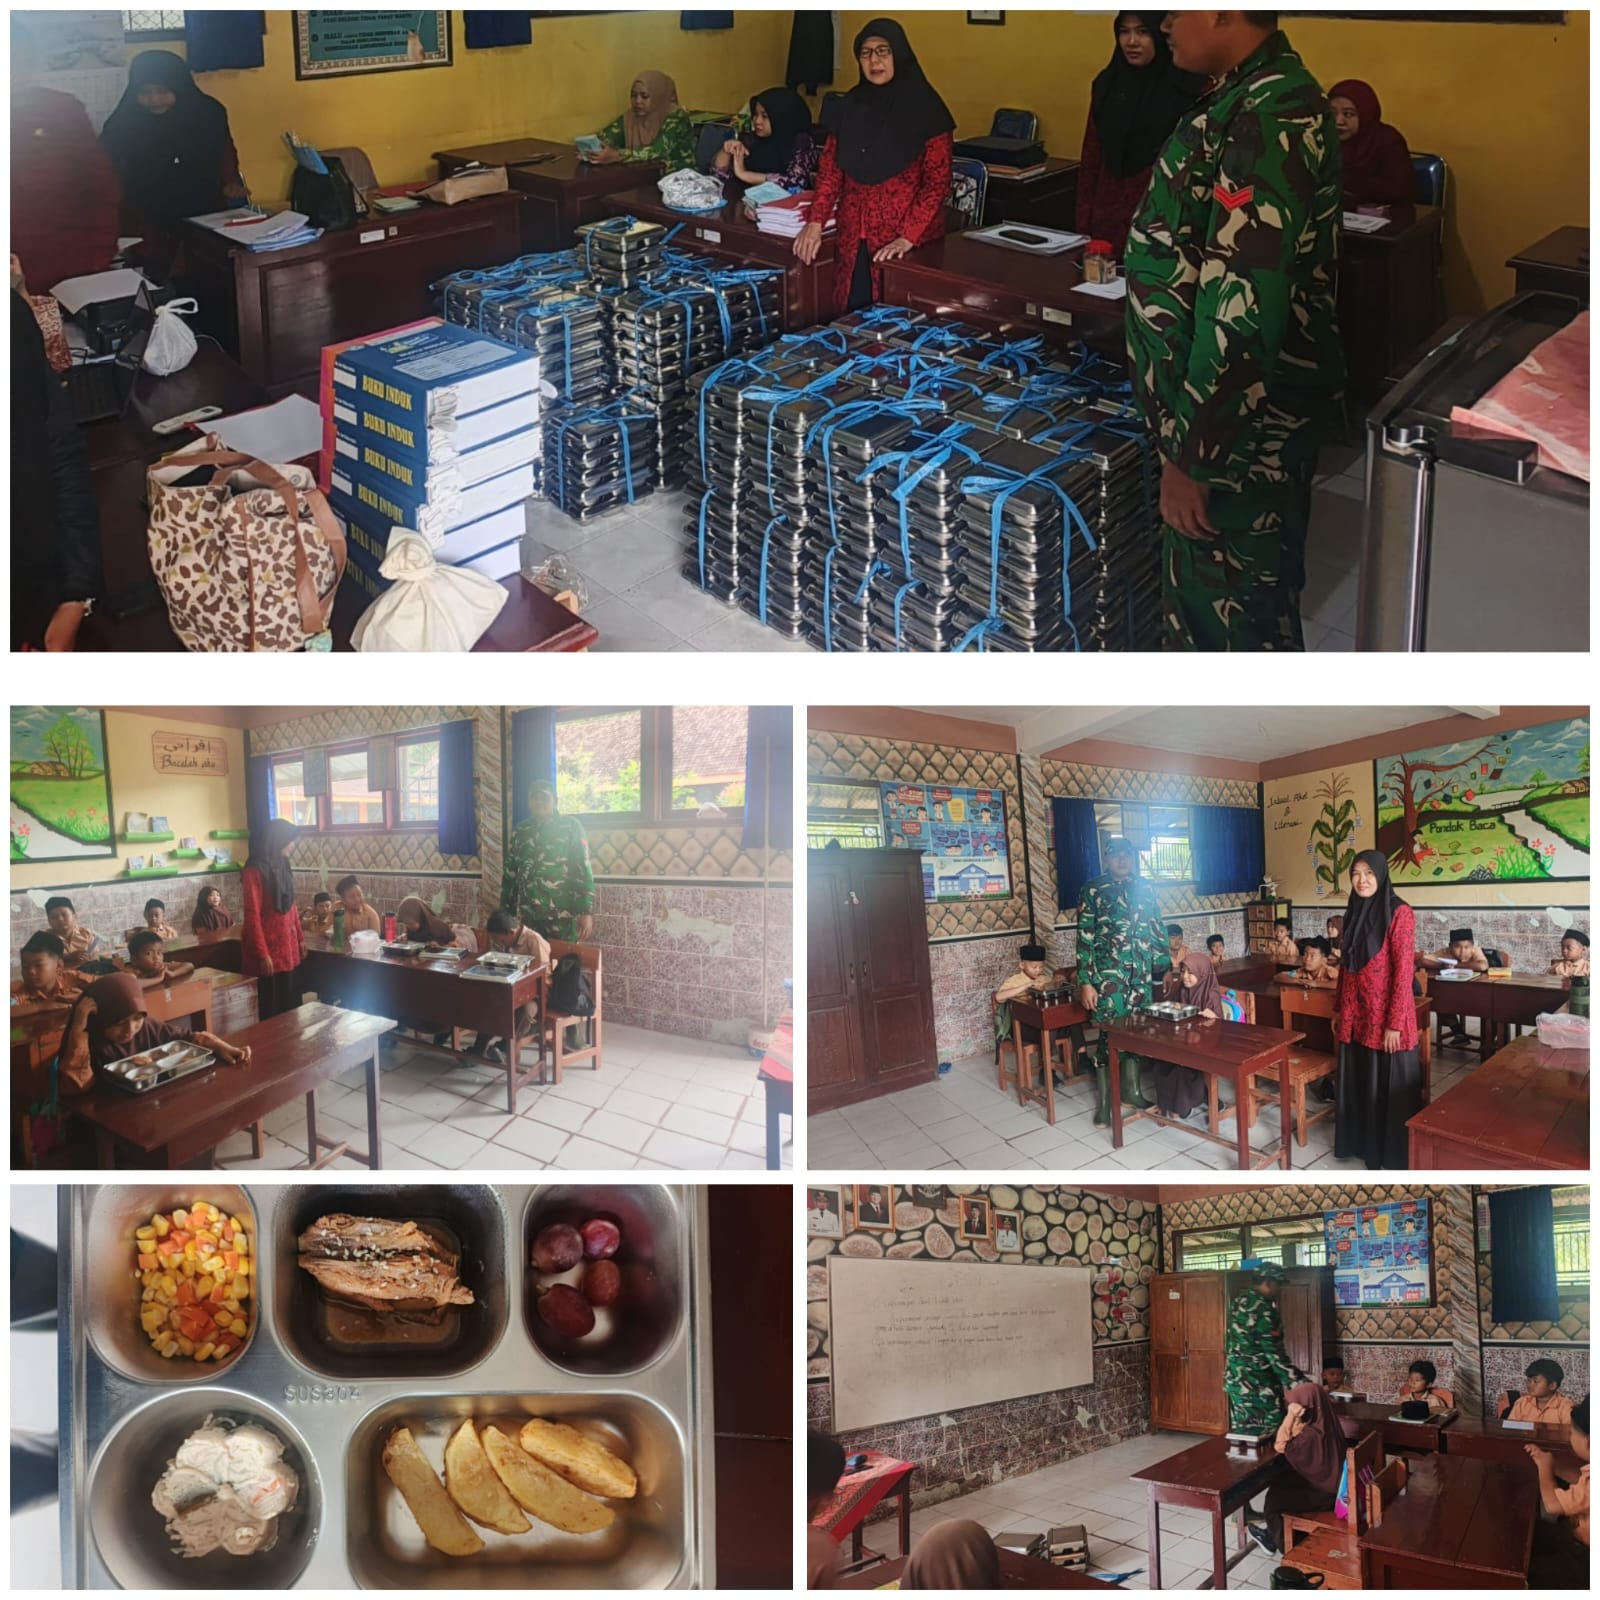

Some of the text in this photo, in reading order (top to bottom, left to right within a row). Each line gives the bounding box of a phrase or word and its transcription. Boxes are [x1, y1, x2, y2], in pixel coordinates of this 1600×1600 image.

[362, 374, 385, 399] BUKU
[385, 384, 413, 411] INDUK
[363, 411, 386, 436] BUKU
[386, 421, 415, 448] INDUK
[364, 447, 413, 487] BUKU INDUK
[358, 483, 404, 525] BUKU INDUK
[350, 522, 370, 550] BUKU
[160, 754, 198, 769] Bacalah
[1469, 819, 1497, 831] Baca
